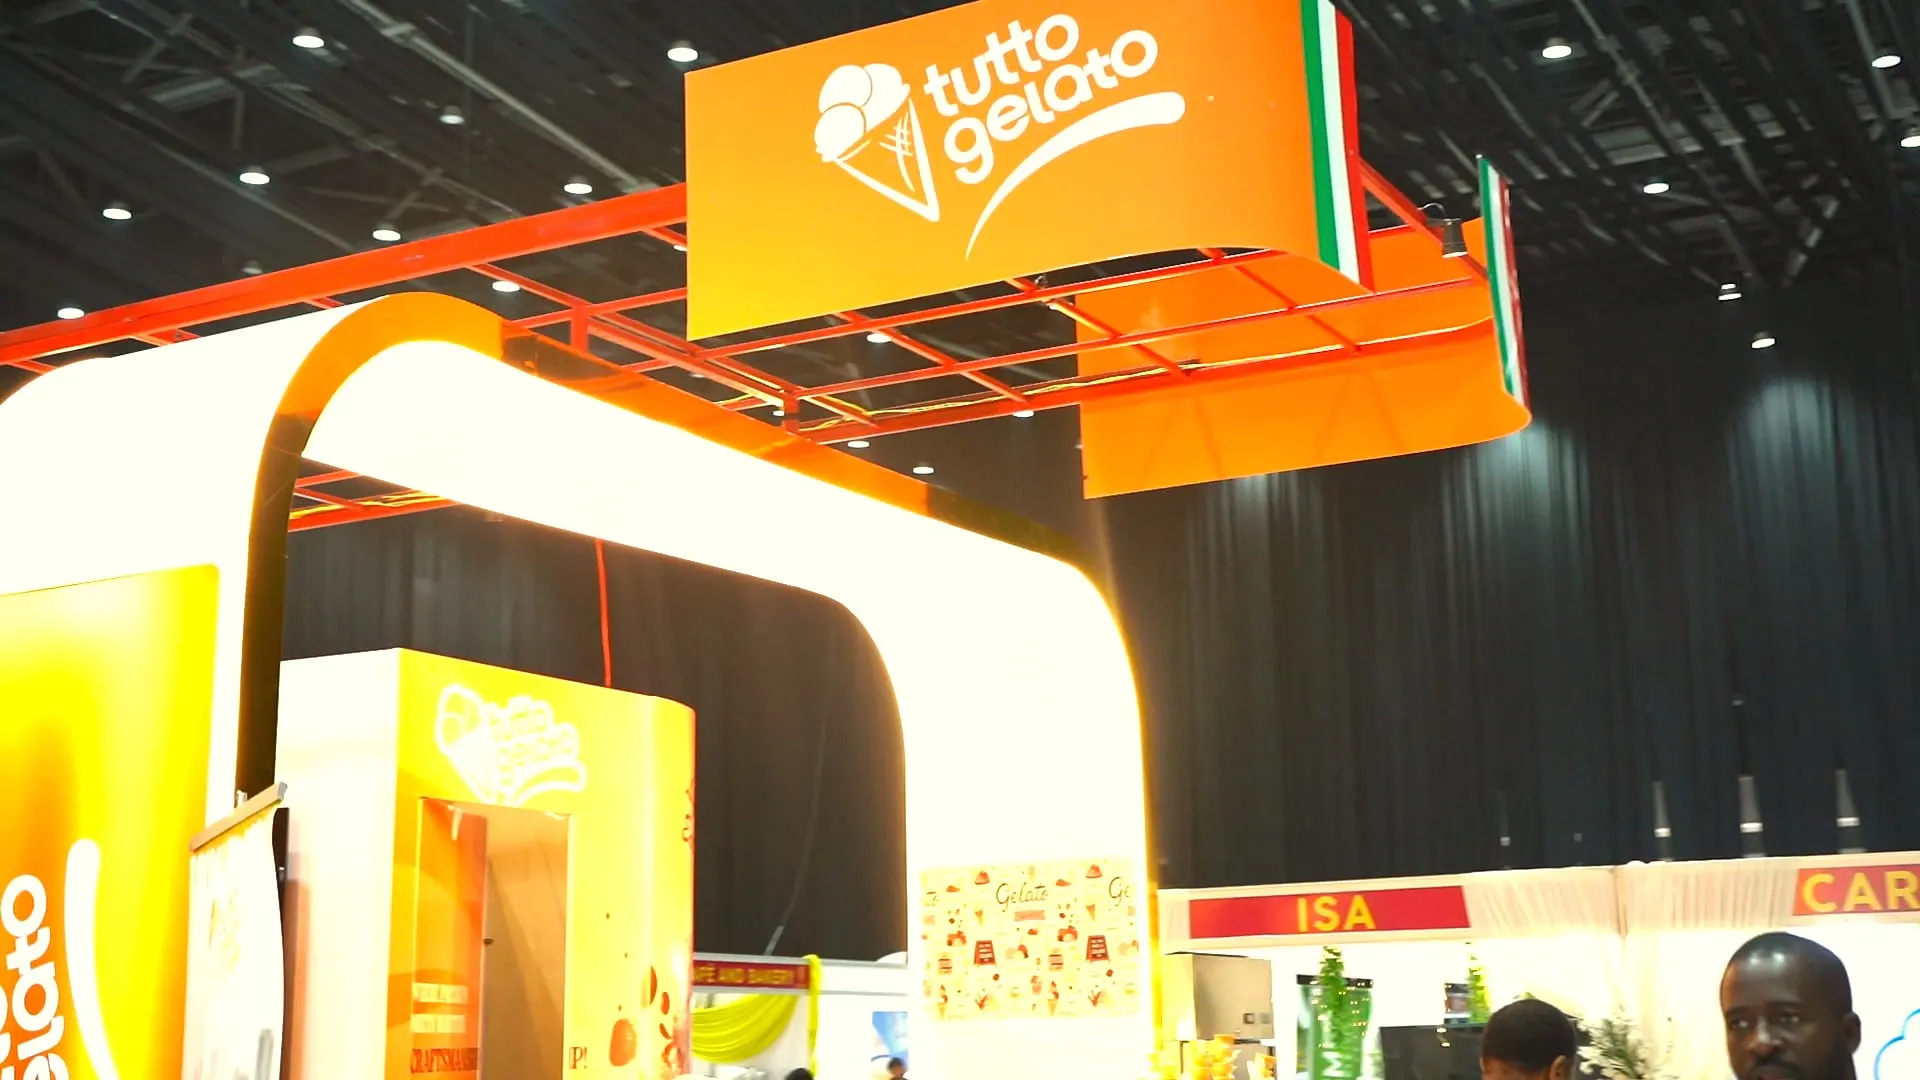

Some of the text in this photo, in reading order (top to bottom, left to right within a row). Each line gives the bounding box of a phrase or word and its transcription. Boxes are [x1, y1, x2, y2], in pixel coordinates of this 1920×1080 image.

[923, 13, 1080, 117] tutto
[943, 29, 1159, 185] gelato
[995, 881, 1049, 913] Gelato
[1803, 870, 1920, 913] CAR
[1297, 895, 1376, 932] ISA
